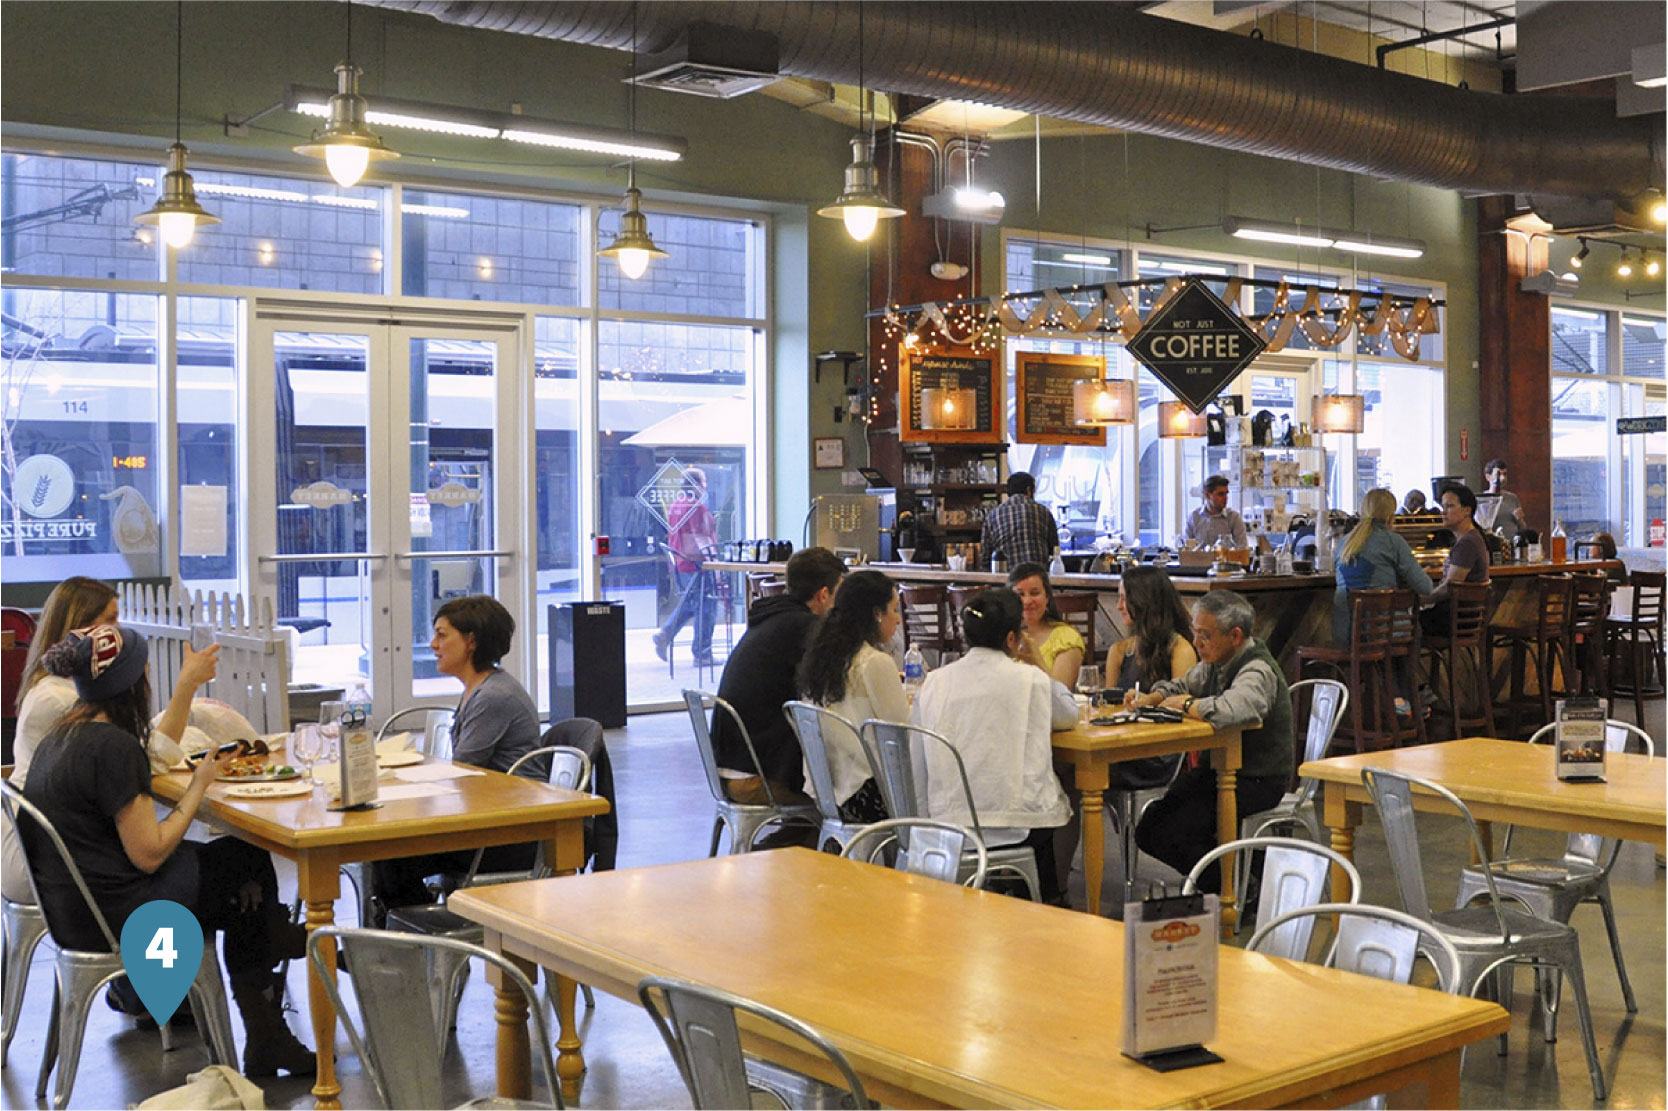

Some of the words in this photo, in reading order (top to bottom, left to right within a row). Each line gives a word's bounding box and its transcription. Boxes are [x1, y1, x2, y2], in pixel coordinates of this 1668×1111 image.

[1173, 320, 1190, 328] NOT
[1196, 320, 1214, 328] JUST
[1150, 335, 1240, 358] COFFEE
[63, 401, 88, 413] 114
